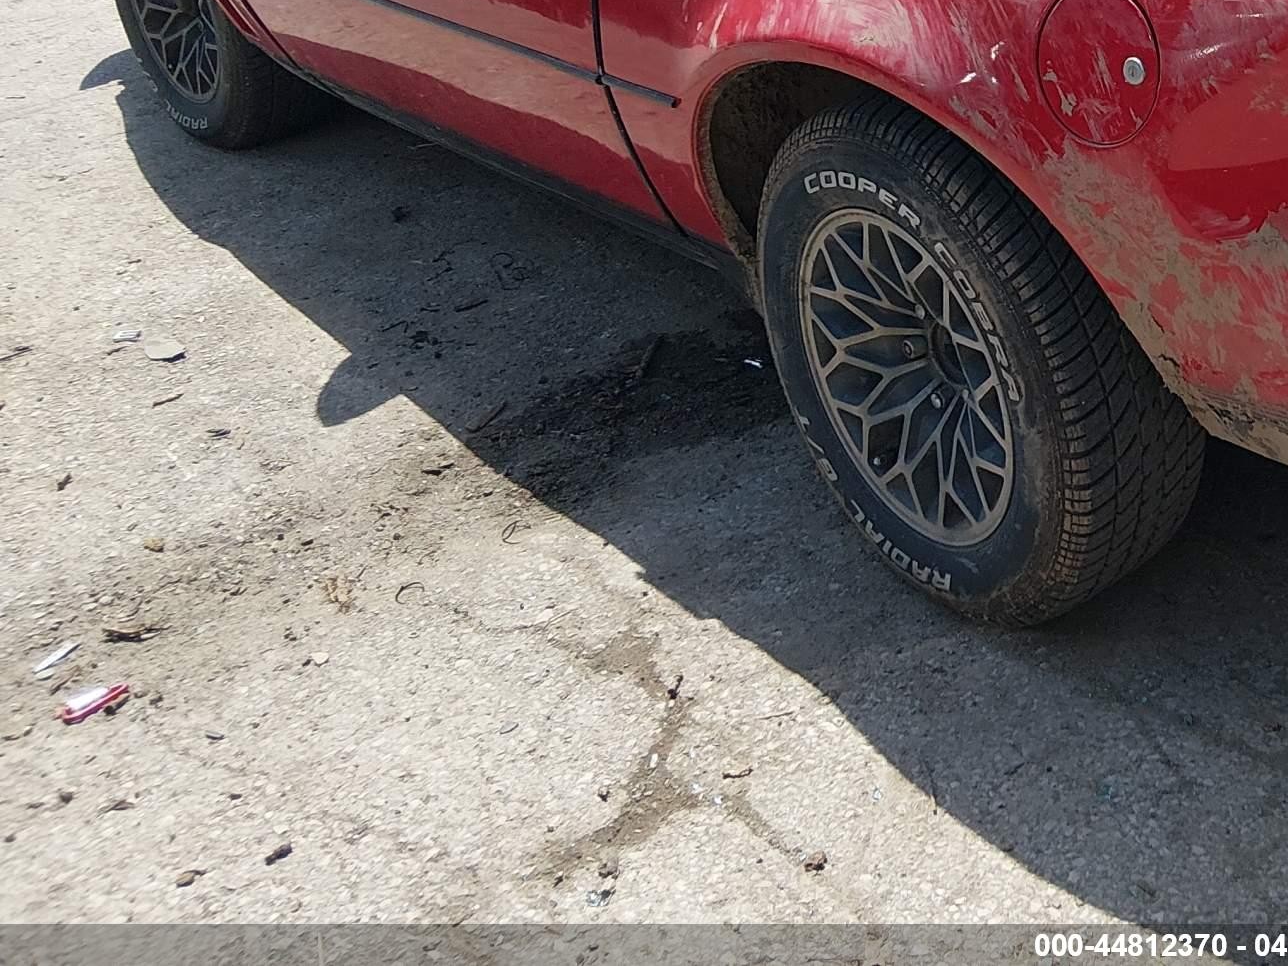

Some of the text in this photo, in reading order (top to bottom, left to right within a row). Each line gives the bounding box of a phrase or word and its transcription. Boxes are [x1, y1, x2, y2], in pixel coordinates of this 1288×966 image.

[164, 98, 208, 130] RADIAL
[804, 170, 1024, 403] COOPER COBRA
[850, 498, 951, 592] RADIAL
